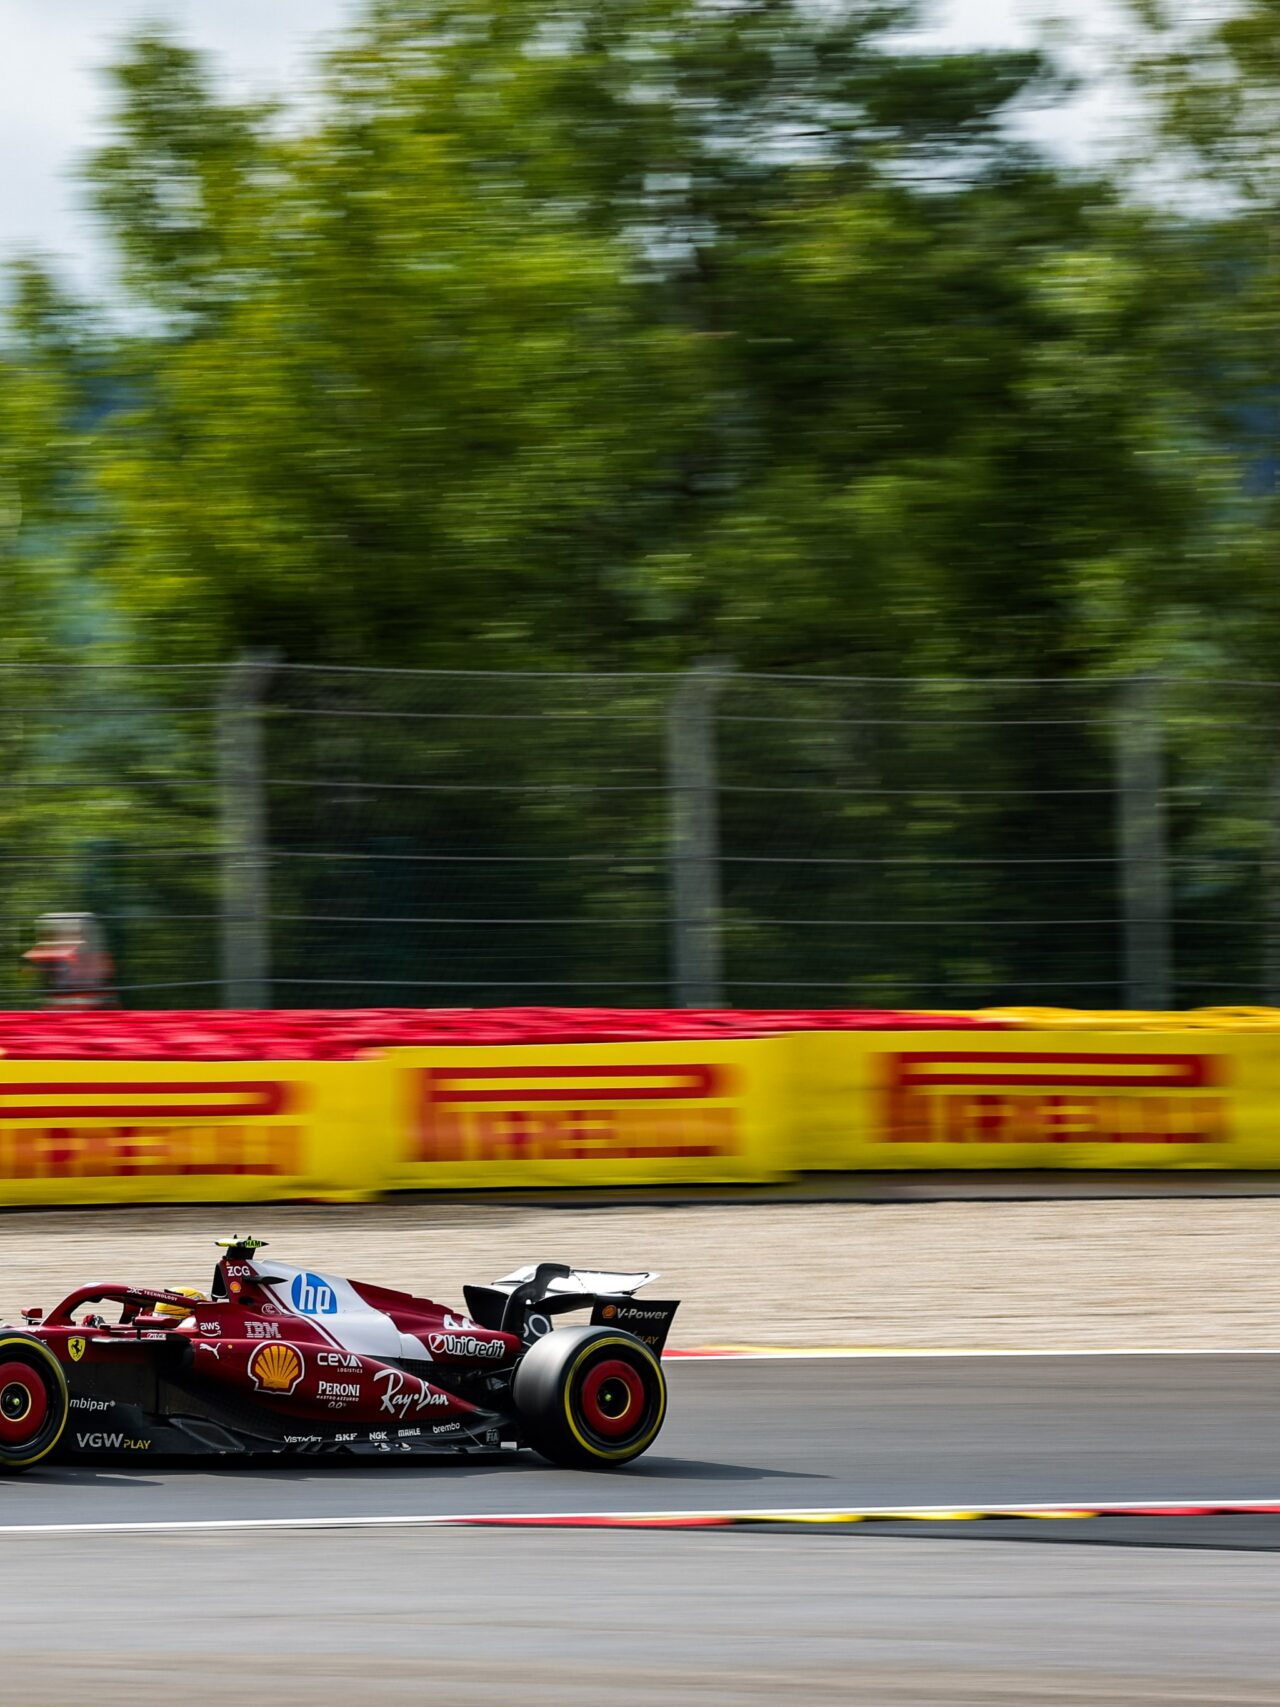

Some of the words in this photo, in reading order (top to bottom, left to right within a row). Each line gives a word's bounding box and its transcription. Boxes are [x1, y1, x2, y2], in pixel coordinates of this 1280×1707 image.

[245, 1240, 261, 1248] HAM
[226, 1265, 251, 1277] ZCG
[144, 1290, 178, 1301] TECHNOLOGY
[299, 1272, 332, 1315] hp
[616, 1308, 668, 1320] V-Power
[200, 1322, 221, 1331] aws
[244, 1321, 282, 1338] IBM
[445, 1334, 505, 1358] UniCredit
[318, 1380, 360, 1396] PERONI
[69, 1397, 109, 1411] mbipar
[397, 1427, 421, 1437] MAHLE
[432, 1421, 461, 1434] brembo
[76, 1432, 124, 1448] VGW
[123, 1439, 152, 1450] PLAY
[334, 1433, 358, 1441] SKF
[369, 1431, 388, 1441] NGK
